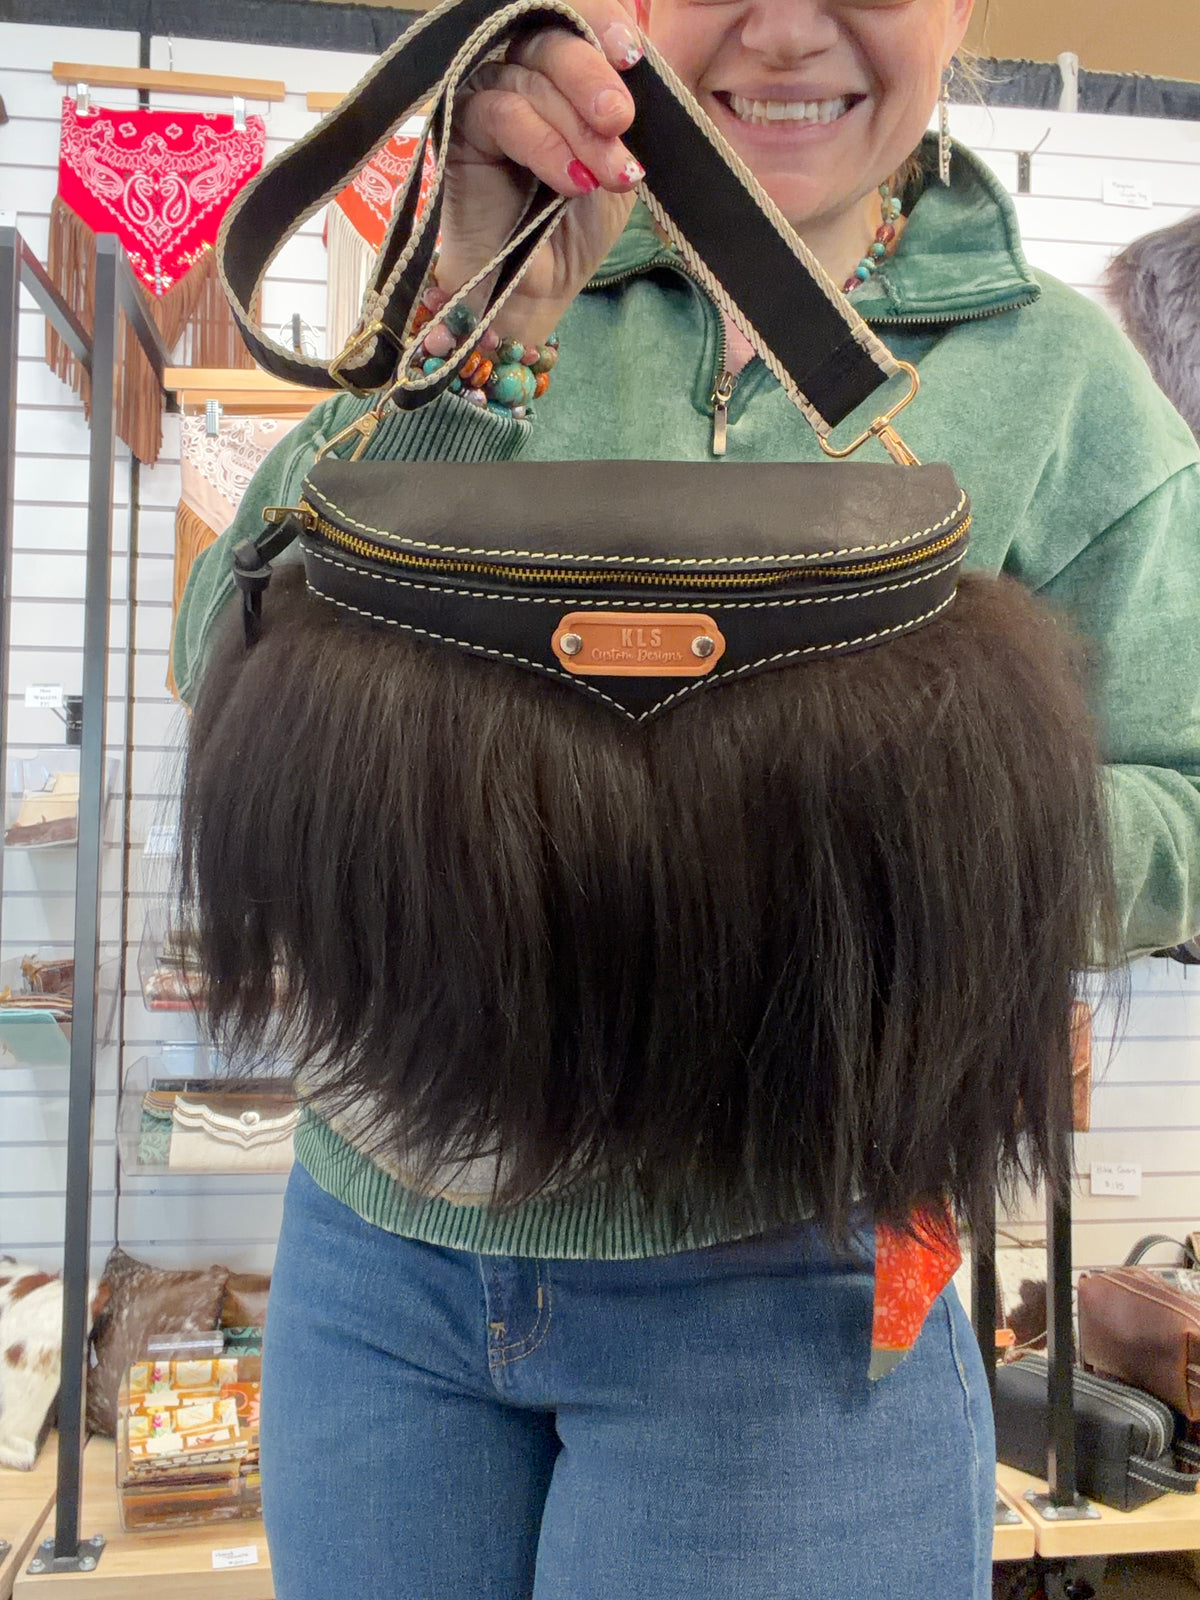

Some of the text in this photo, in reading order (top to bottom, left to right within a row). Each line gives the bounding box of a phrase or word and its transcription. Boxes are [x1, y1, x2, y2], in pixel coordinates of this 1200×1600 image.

[621, 628, 662, 648] KLS
[591, 647, 684, 664] Custom Designs
